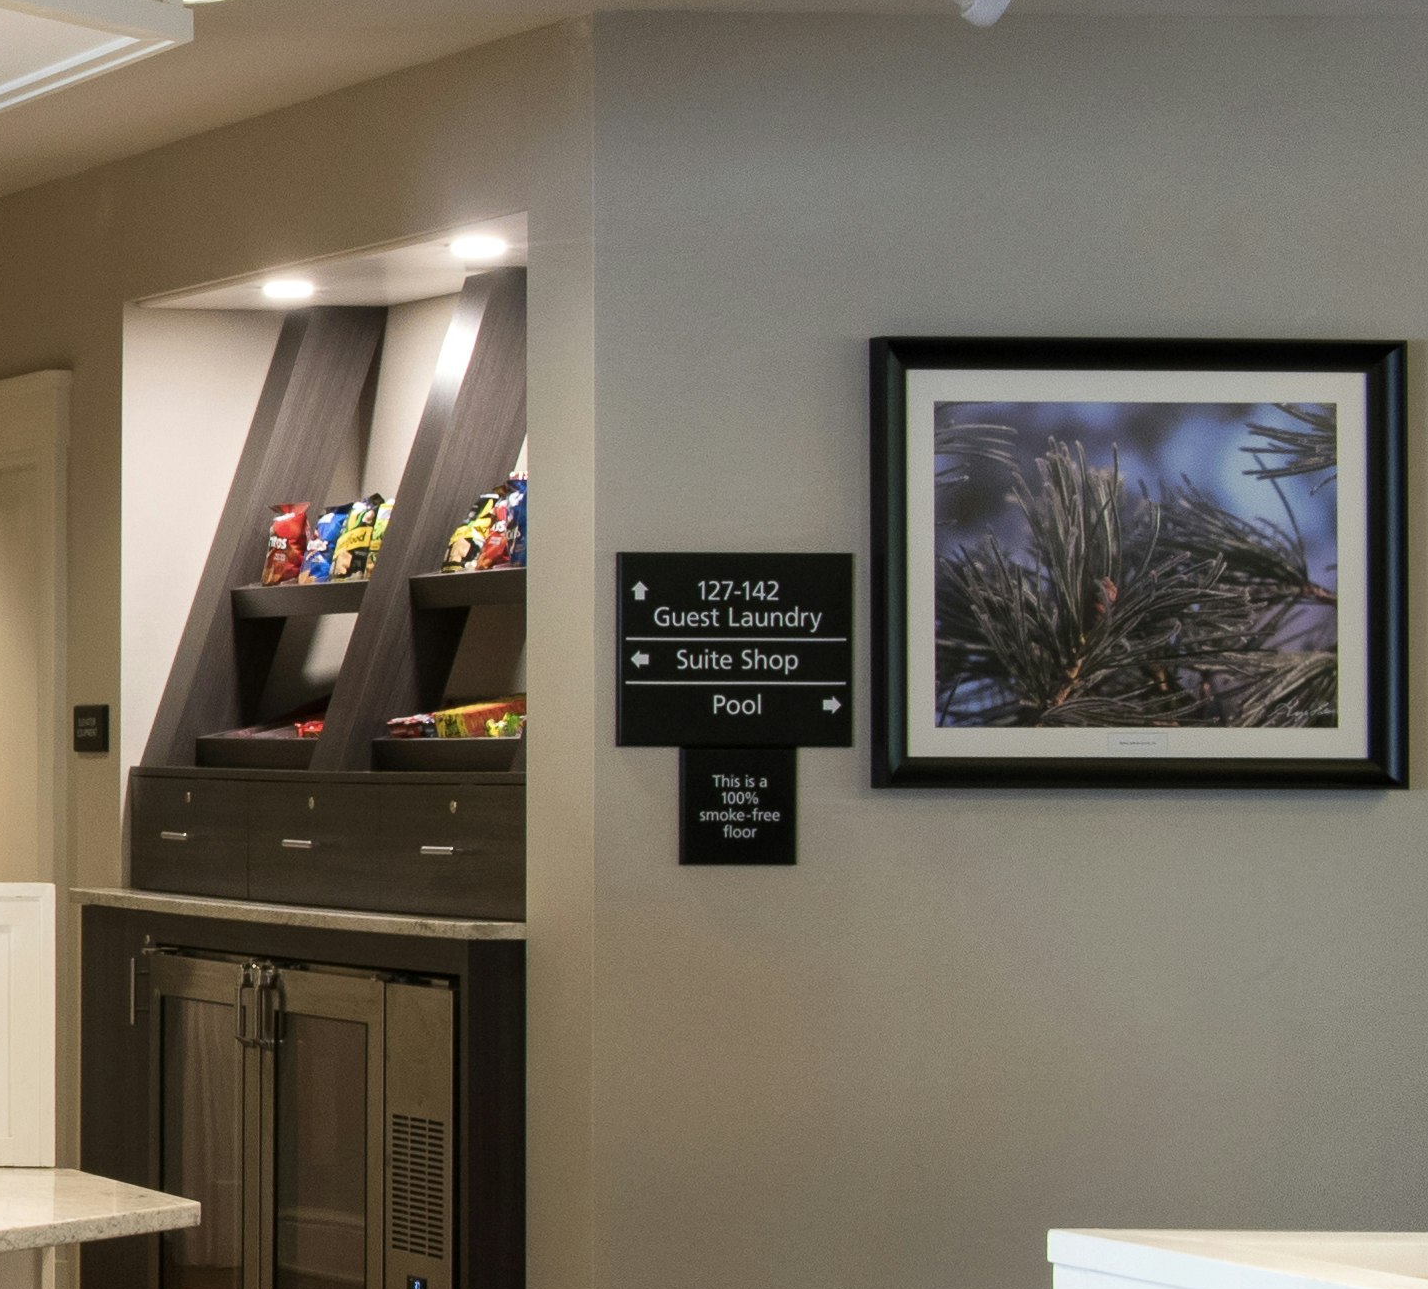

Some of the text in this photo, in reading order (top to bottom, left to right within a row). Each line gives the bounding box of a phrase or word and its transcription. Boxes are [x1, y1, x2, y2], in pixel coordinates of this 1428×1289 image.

[697, 580, 780, 601] 127-142
[654, 606, 823, 633] Guest Laundry
[676, 648, 799, 675] Suite Shop
[713, 693, 762, 715] Pool
[712, 774, 768, 788] This is a
[721, 791, 759, 804] 100%
[699, 807, 781, 822] smoke-free
[722, 824, 757, 838] floor
